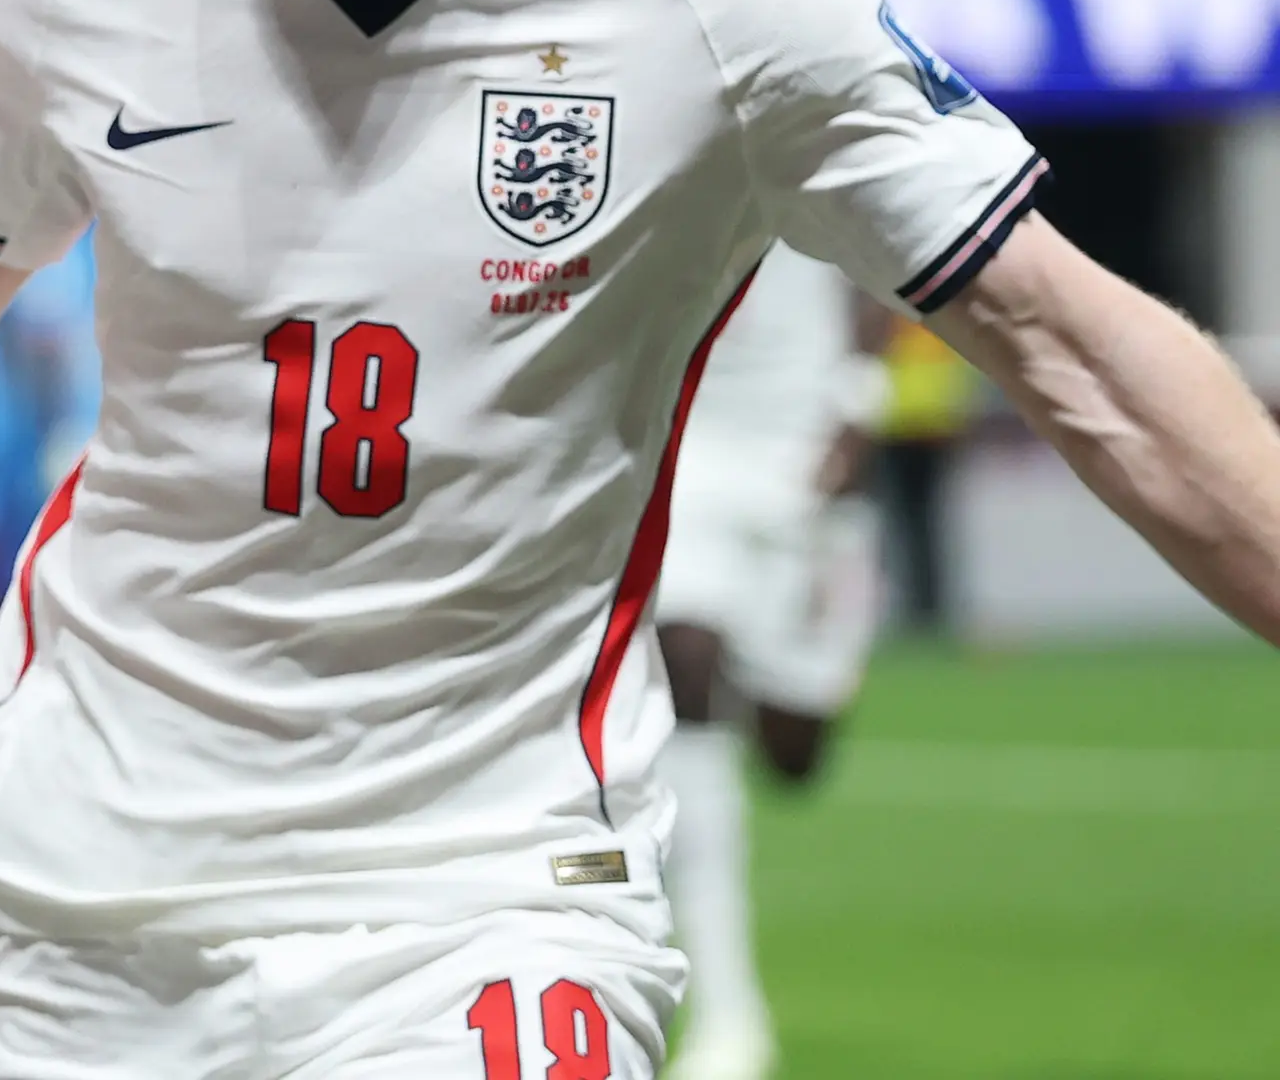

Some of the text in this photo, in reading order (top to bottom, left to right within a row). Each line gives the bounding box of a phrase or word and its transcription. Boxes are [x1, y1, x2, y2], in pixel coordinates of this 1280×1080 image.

[481, 258, 557, 282] CONGO
[262, 317, 419, 518] 18
[466, 977, 612, 1080] 18
